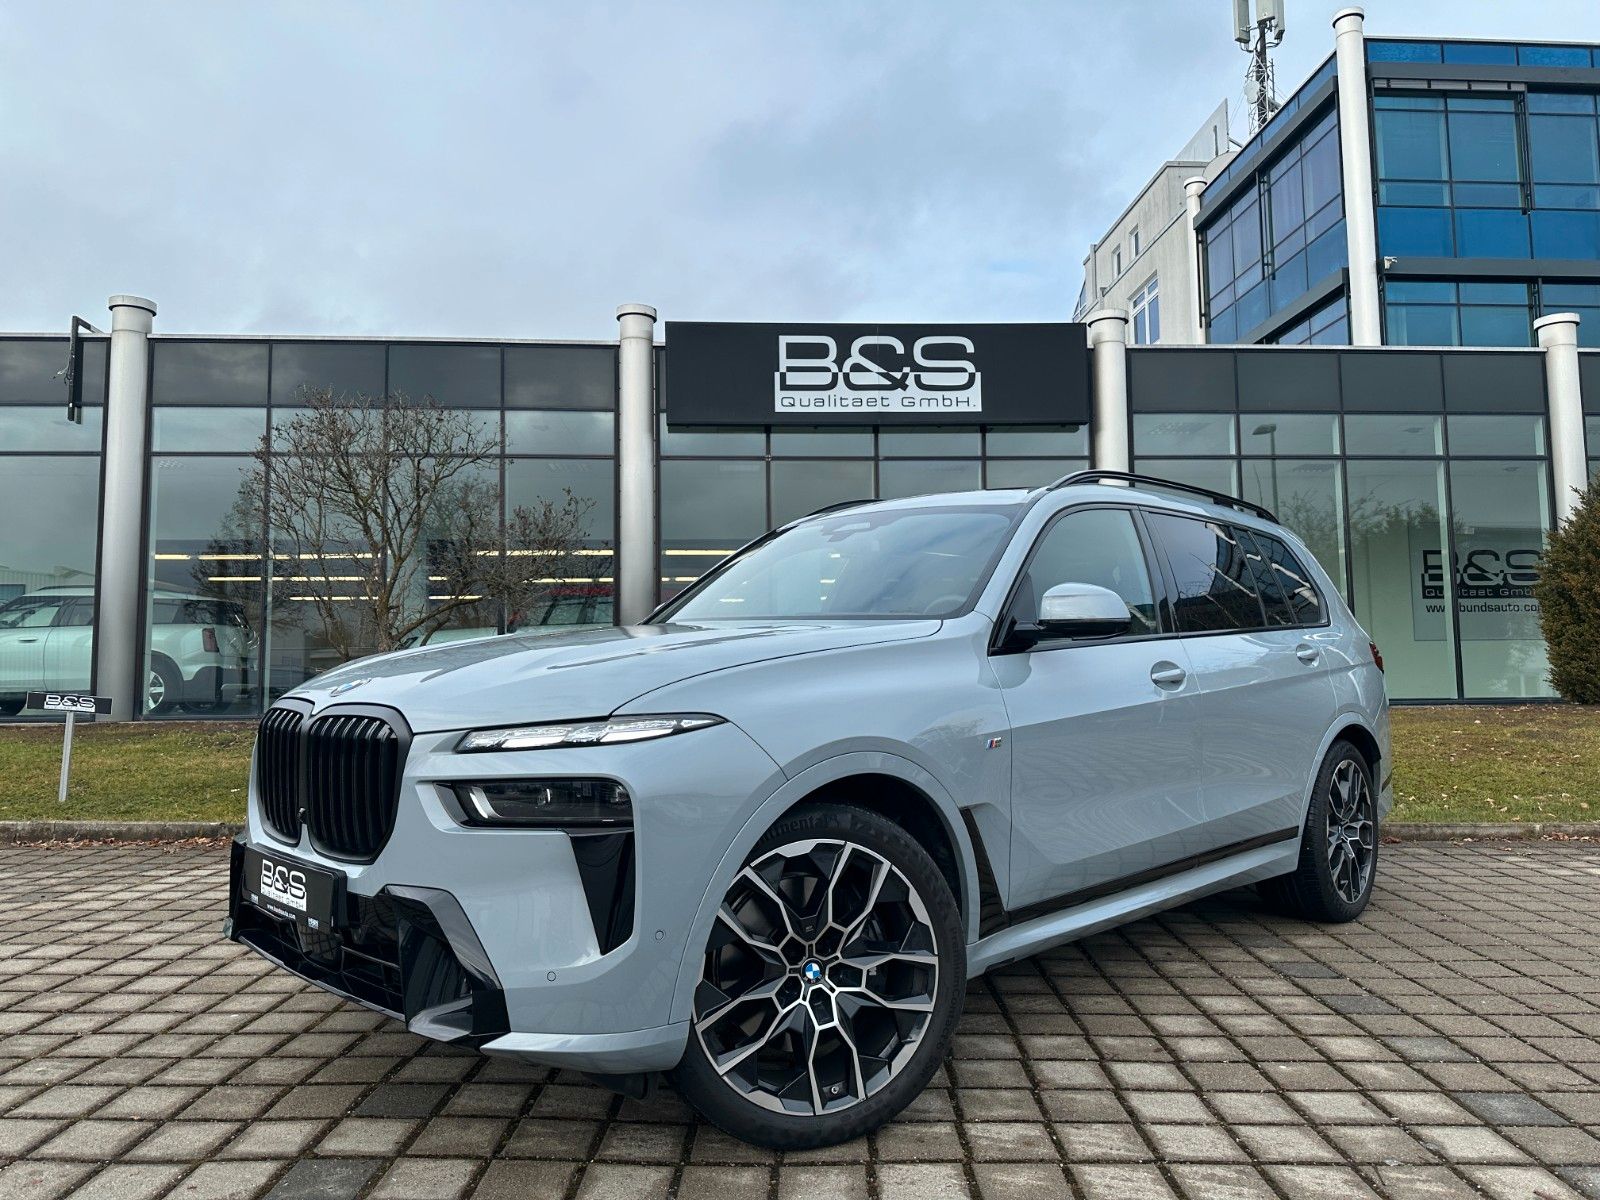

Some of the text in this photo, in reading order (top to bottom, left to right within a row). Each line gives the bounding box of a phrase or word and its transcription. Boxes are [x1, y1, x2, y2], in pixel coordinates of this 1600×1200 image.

[778, 335, 976, 391] B&S
[780, 394, 890, 408] Qualitaet
[1423, 550, 1543, 586] B&S
[1425, 586, 1536, 597] Quitaet Gmb
[46, 695, 95, 708] B&S
[262, 859, 306, 900] B&S
